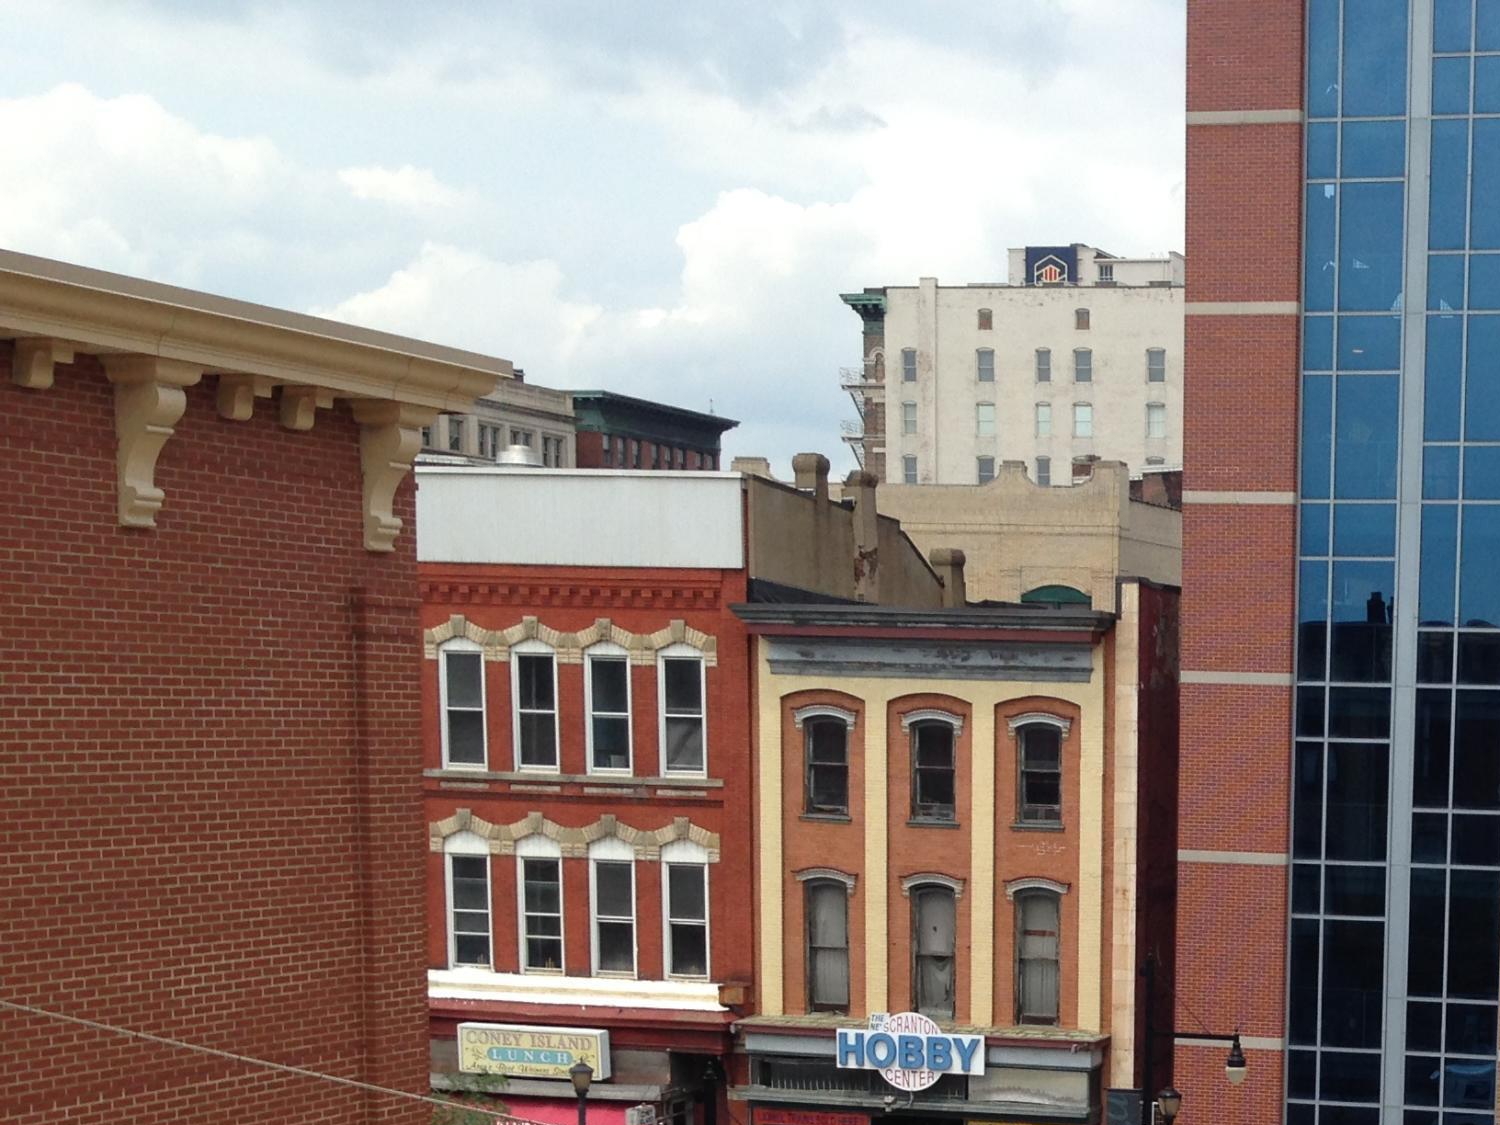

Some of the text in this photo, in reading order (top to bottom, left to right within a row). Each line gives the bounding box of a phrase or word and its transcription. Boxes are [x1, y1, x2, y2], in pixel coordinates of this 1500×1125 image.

[871, 1014, 885, 1022] THE
[883, 1015, 938, 1035] SCRANTON
[466, 1030, 592, 1051] CONEY ISLAND
[492, 1048, 569, 1064] LUNCH
[838, 1031, 980, 1073] HOBBY
[885, 1068, 935, 1087] CENTER
